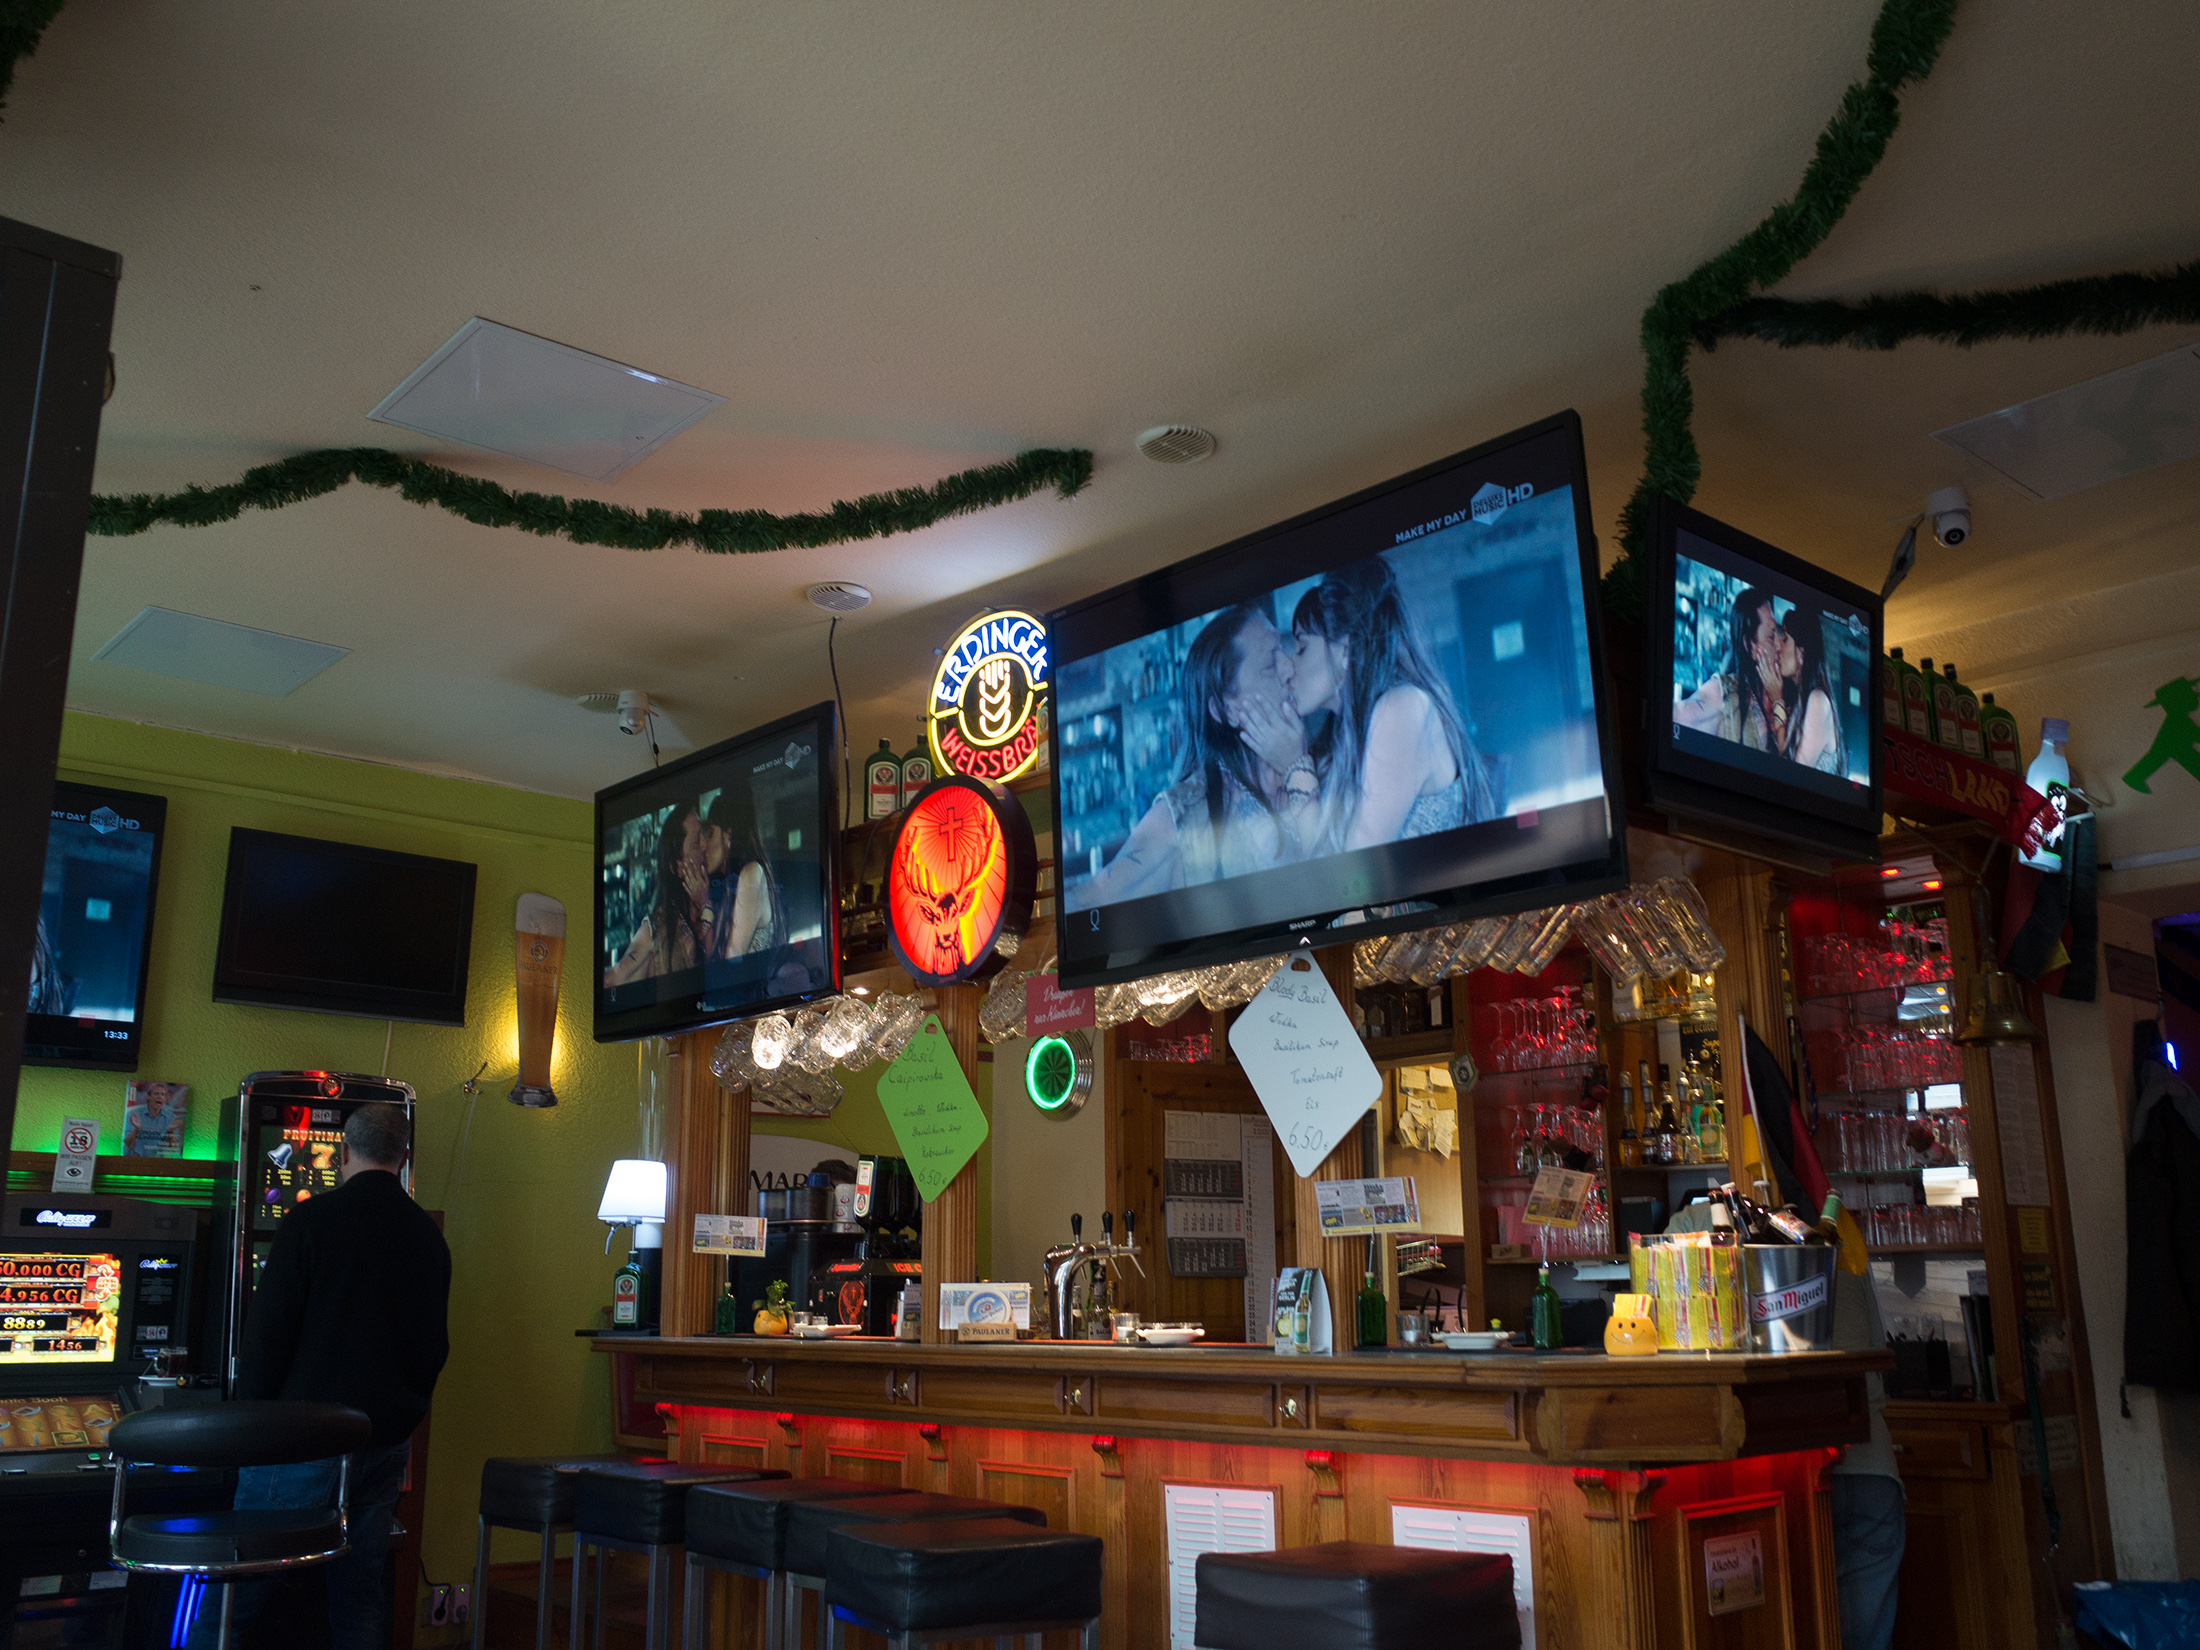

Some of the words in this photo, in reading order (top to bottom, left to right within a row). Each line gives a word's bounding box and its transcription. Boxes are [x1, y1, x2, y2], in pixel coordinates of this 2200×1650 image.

[1473, 492, 1504, 508] DELUXE
[1507, 482, 1534, 504] HD
[1473, 500, 1505, 517] MUSIC
[1395, 524, 1424, 544] MAKE
[1426, 517, 1443, 533] MY
[1444, 508, 1467, 526] DAY
[940, 714, 1039, 778] WEISSBRÄ
[51, 810, 65, 819] MY
[67, 812, 86, 821] DAY
[120, 818, 140, 830] HD
[1289, 919, 1317, 931] SHARP
[104, 1030, 129, 1040] 13:33
[1305, 1096, 1320, 1111] Eis
[69, 1135, 88, 1146] 18
[283, 1128, 346, 1142] FRUITINA
[56, 1263, 81, 1279] CG
[53, 1289, 78, 1304] CG
[1753, 1299, 1783, 1320] San
[1780, 1281, 1824, 1310] Miguel
[3, 1316, 46, 1330] 8889
[972, 1327, 1010, 1336] PAULANER
[48, 1339, 83, 1351] 1456
